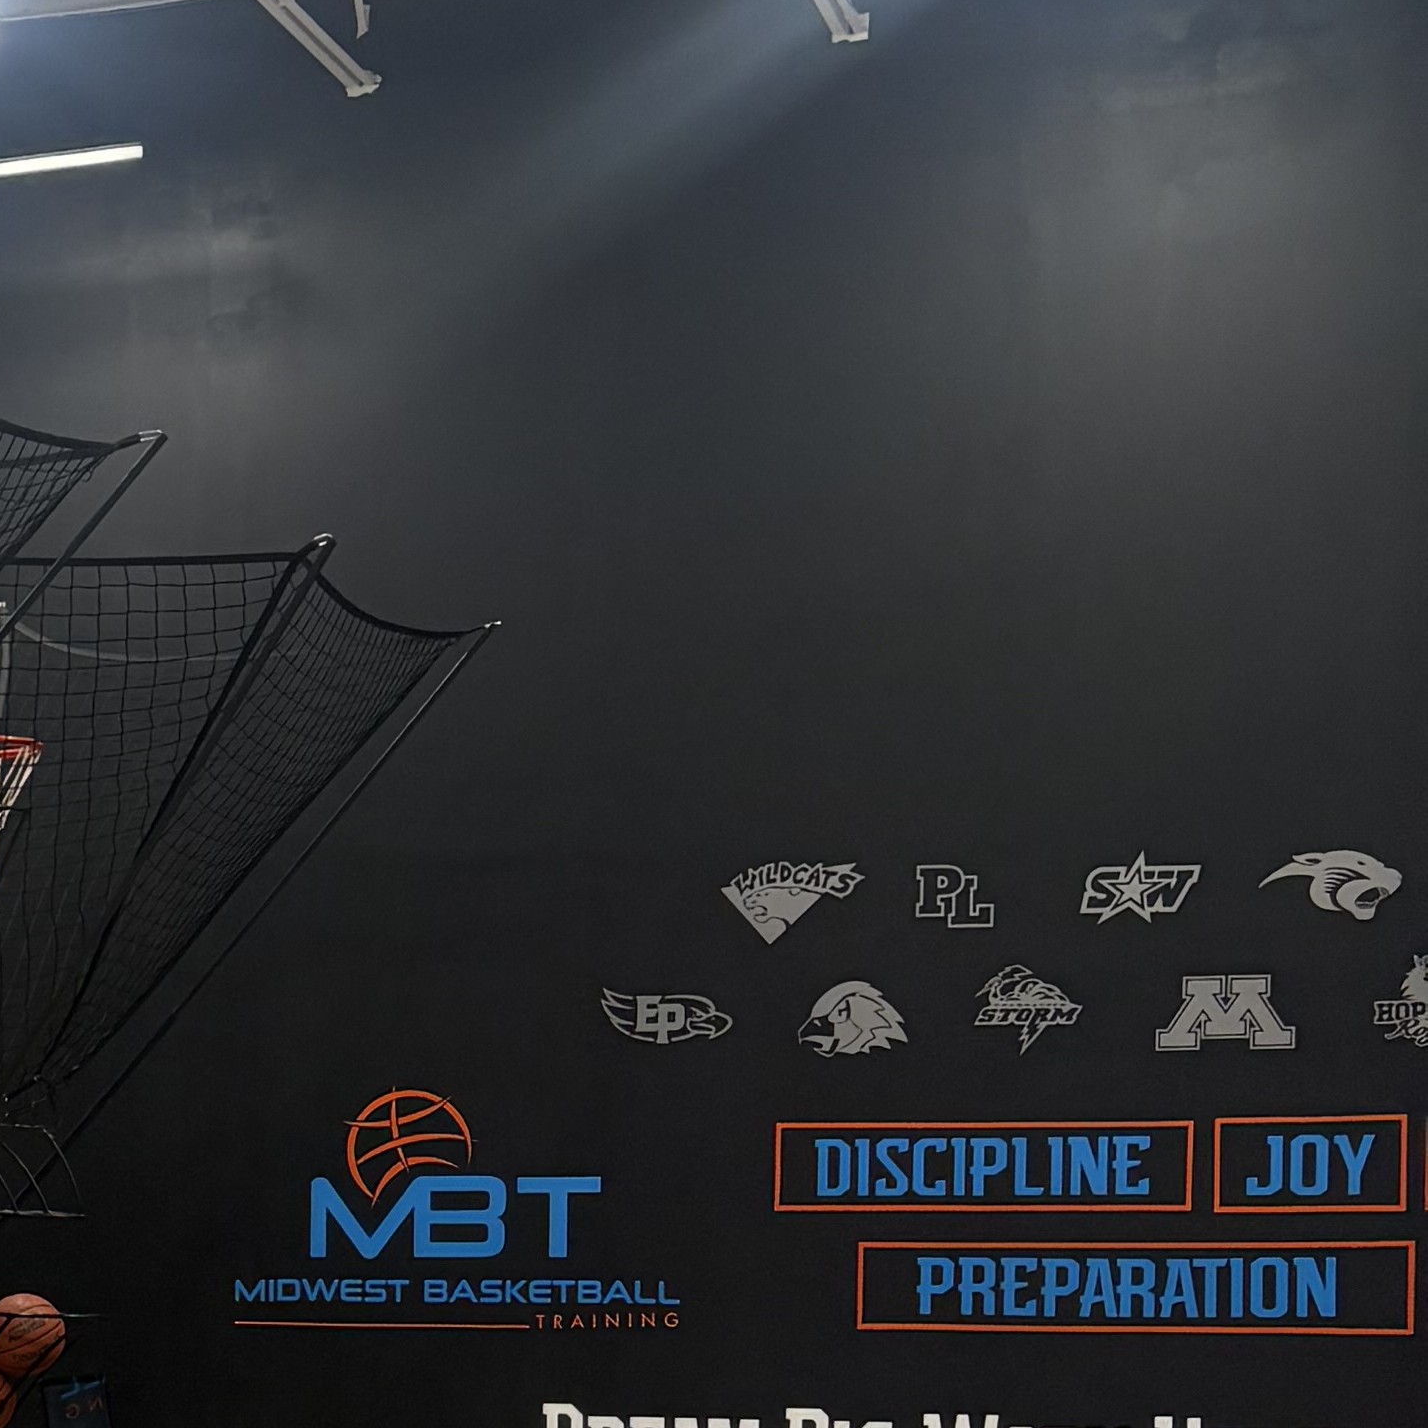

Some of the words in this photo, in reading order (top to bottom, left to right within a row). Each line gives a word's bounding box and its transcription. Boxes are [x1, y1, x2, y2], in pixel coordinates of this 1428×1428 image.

[730, 861, 860, 898] WILDCATS
[916, 864, 994, 928] PL
[635, 995, 685, 1044] EP
[974, 1004, 1082, 1025] STORM
[1155, 974, 1296, 1051] M
[814, 1134, 1152, 1197] DISCIPLINE
[1244, 1133, 1377, 1197] JOY
[310, 1175, 602, 1259] MBT
[234, 1278, 410, 1303] MIDWEST
[423, 1278, 680, 1305] BASKETBALL
[916, 1256, 1337, 1319] PREPARATION
[535, 1312, 680, 1330] TRAINING
